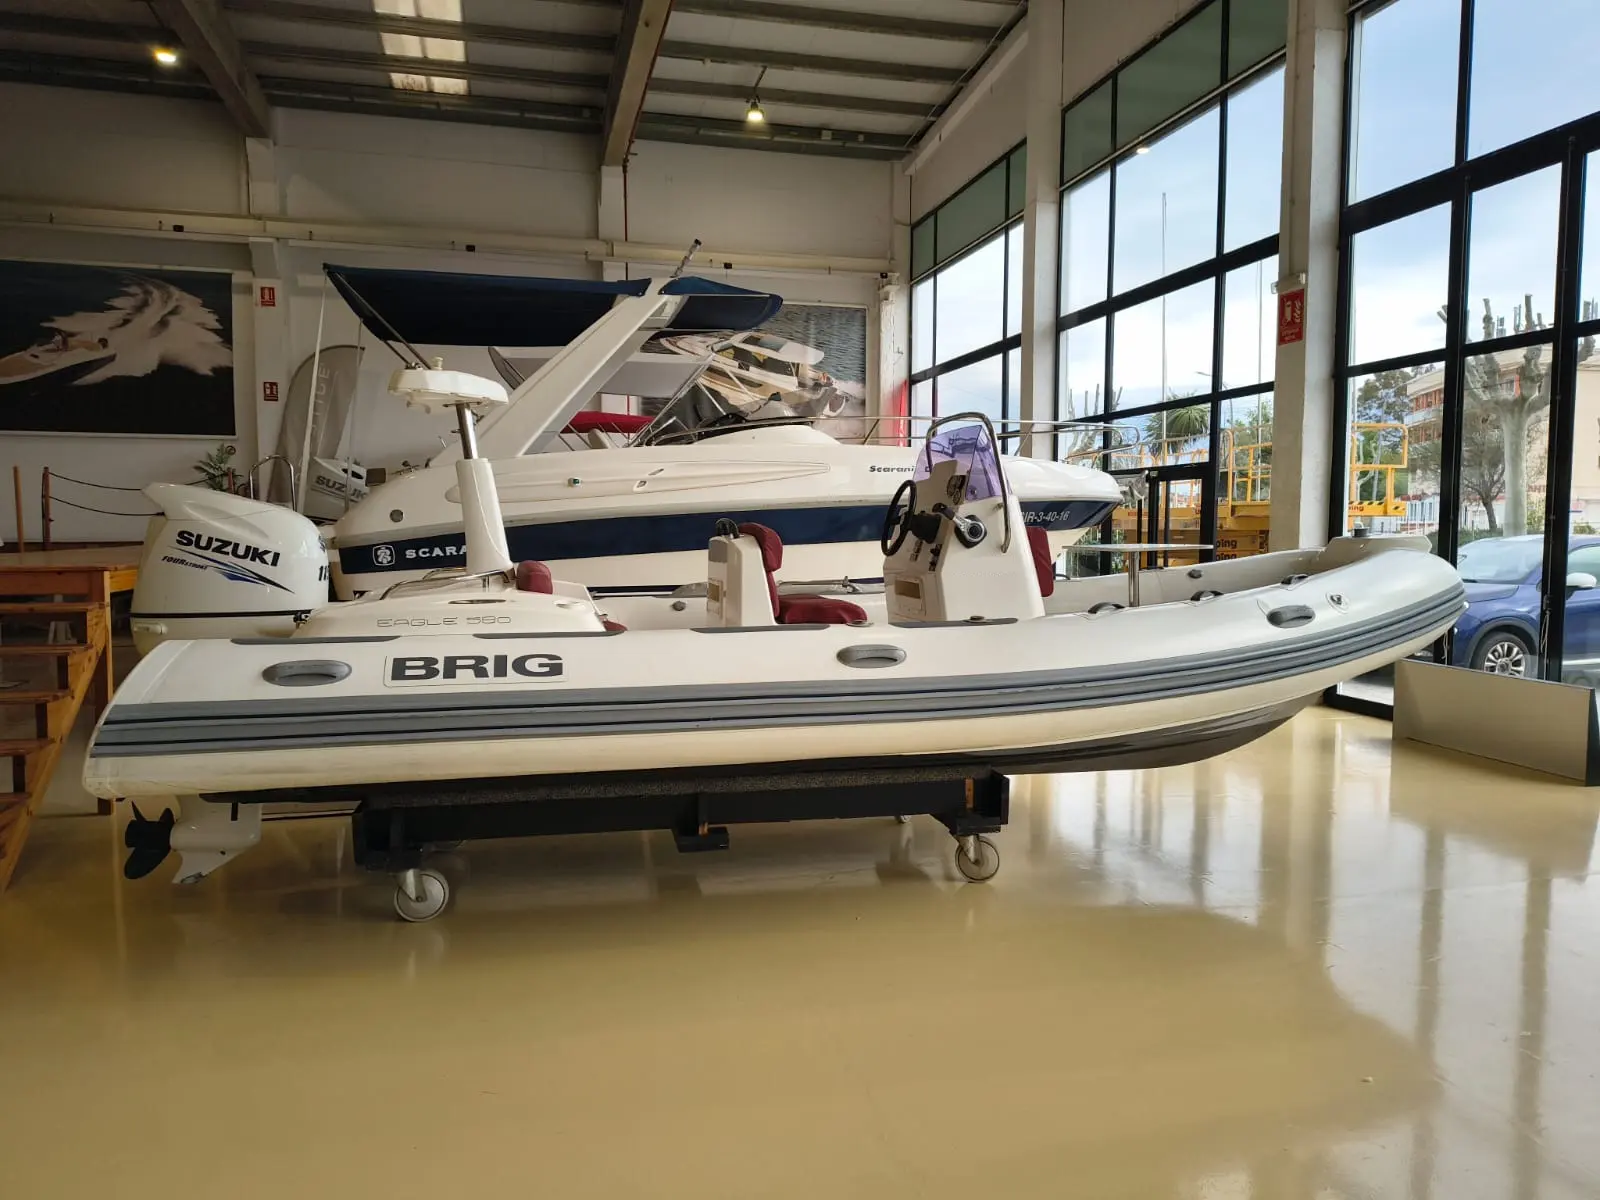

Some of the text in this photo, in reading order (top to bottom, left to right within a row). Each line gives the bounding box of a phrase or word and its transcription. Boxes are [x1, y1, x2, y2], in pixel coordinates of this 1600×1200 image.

[176, 530, 280, 567] SUZUKI
[405, 545, 467, 559] SCARA
[377, 617, 458, 628] EAGLE
[391, 653, 563, 681] BRIG
